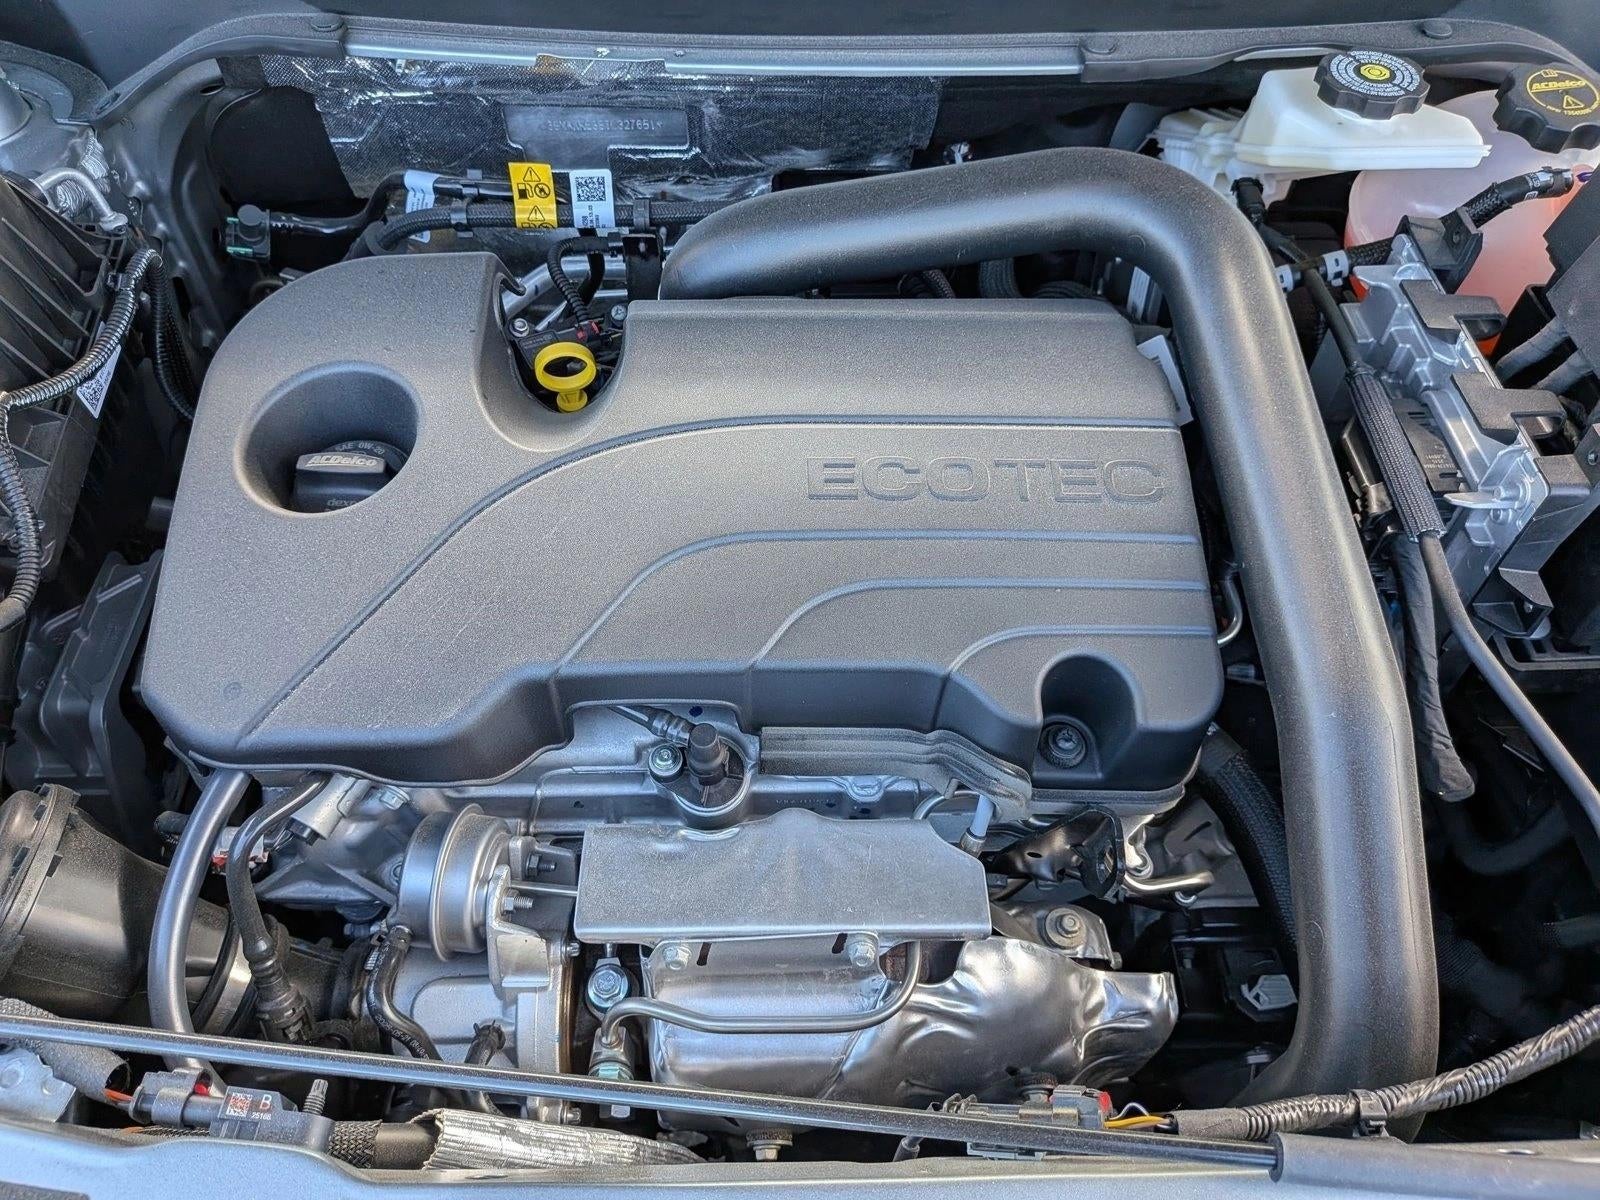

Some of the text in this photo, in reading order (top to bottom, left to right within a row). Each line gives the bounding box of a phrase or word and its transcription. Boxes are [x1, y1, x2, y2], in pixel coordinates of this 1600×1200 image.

[1531, 80, 1586, 92] ACDelco
[358, 441, 386, 455] 0W-20
[305, 455, 378, 467] ACDelco
[806, 456, 1165, 503] ECOTEC
[259, 1093, 273, 1110] B
